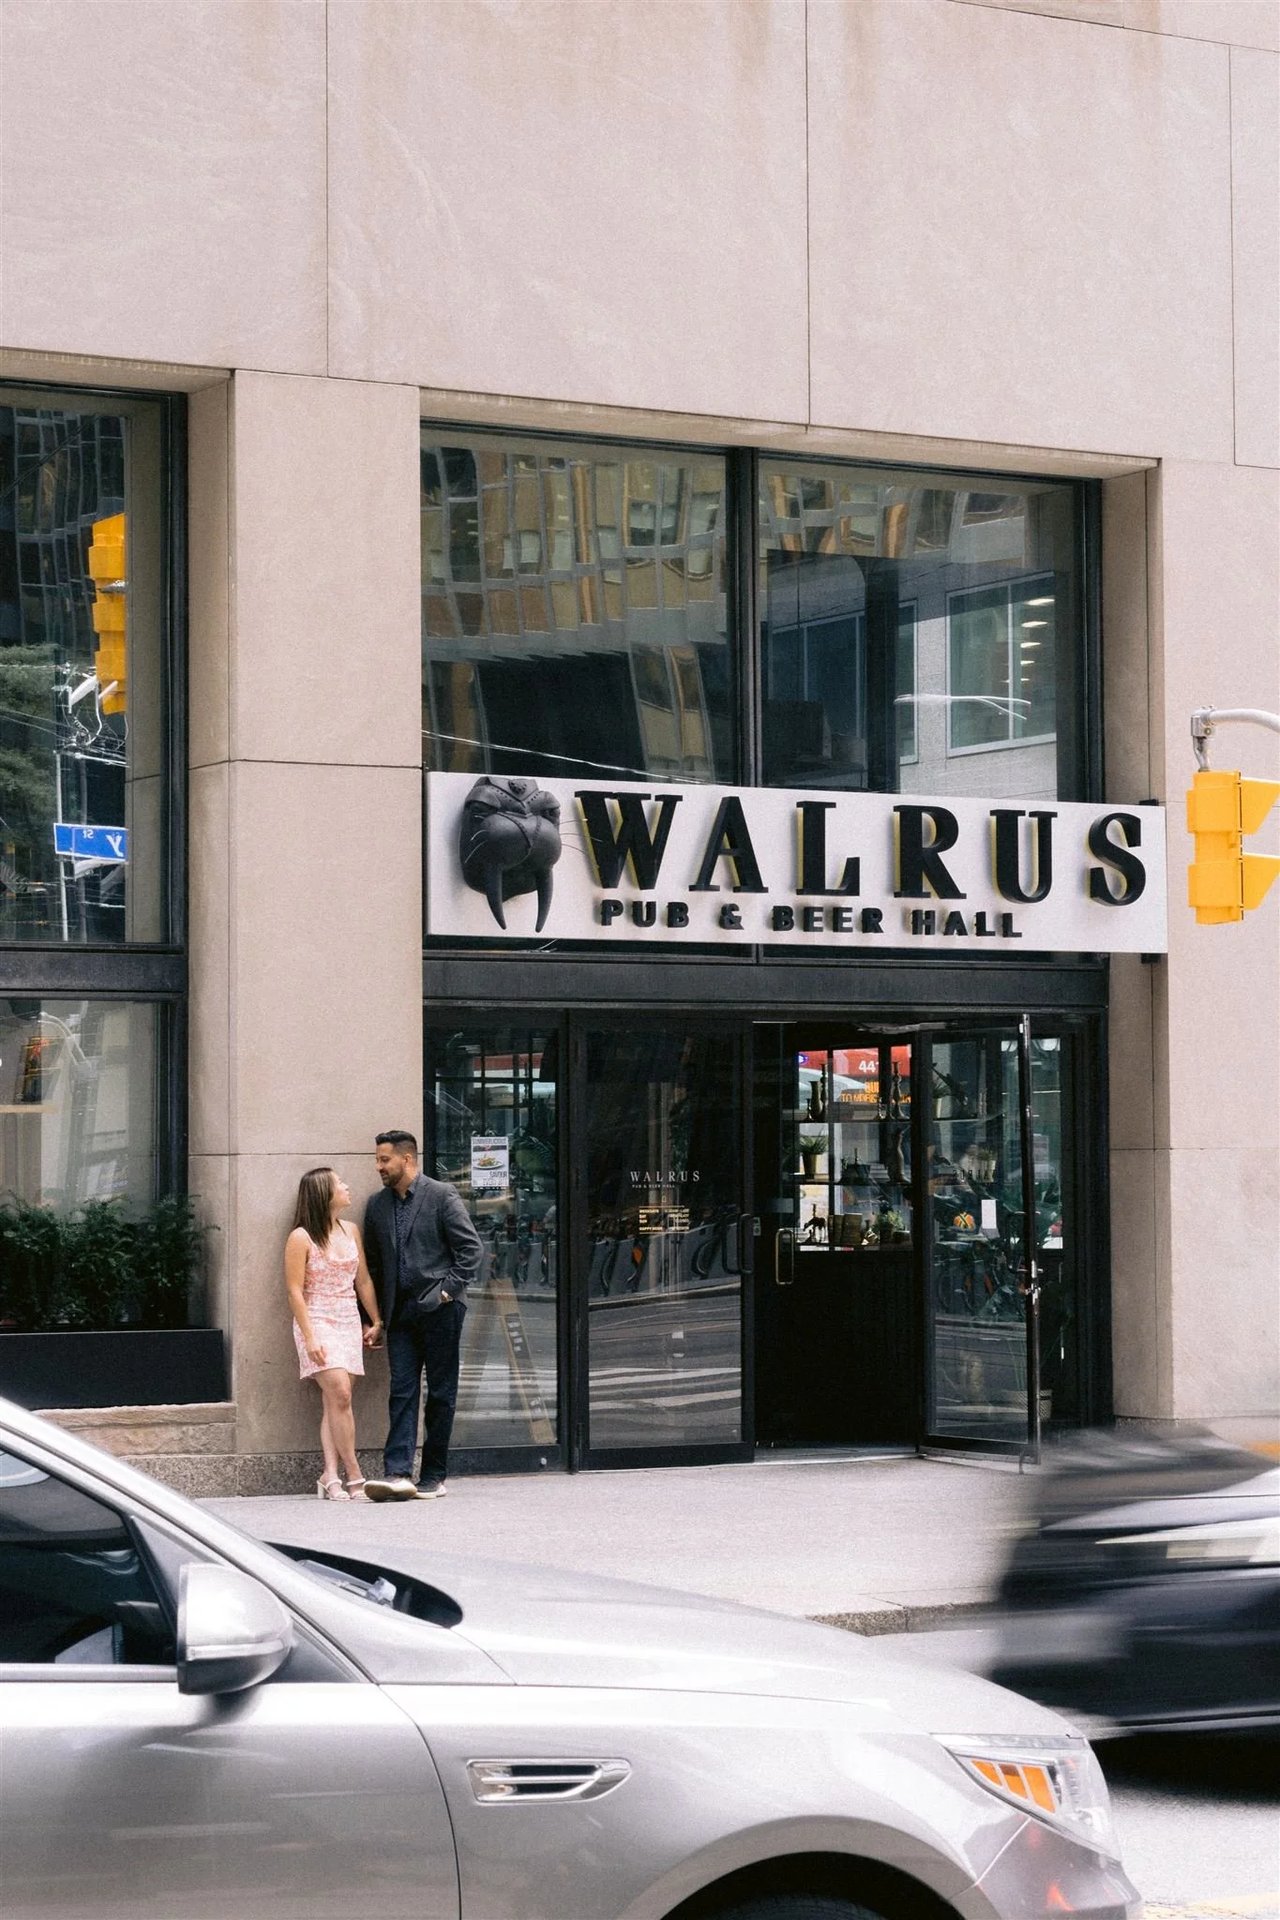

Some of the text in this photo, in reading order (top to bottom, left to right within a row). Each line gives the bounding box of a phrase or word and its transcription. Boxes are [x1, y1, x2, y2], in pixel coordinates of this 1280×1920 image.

[573, 789, 1147, 907] WALRUS
[601, 899, 1023, 938] PUB & BEER HALL
[630, 1170, 700, 1182] WALRUS
